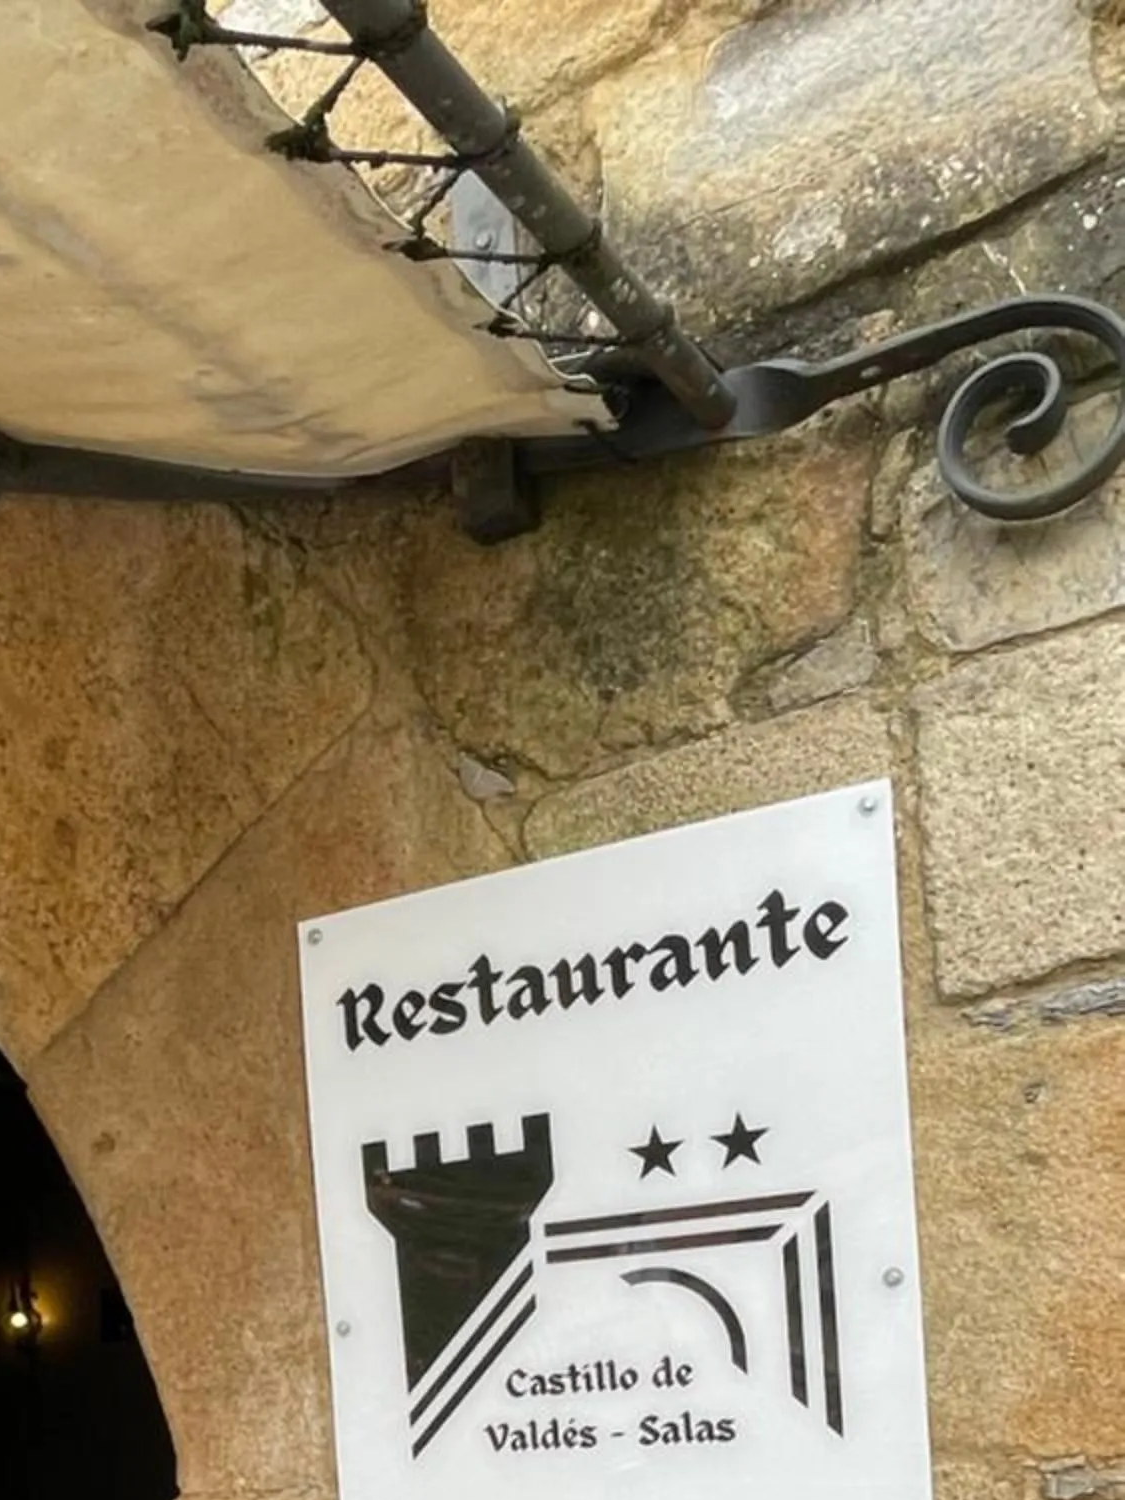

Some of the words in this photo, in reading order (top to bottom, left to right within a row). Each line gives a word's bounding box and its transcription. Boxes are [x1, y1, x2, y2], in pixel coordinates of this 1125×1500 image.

[336, 888, 850, 1052] Restaurante
[505, 1359, 639, 1398] Castillo
[652, 1354, 694, 1388] de
[484, 1417, 598, 1452] Valdés
[638, 1410, 737, 1446] Salas
